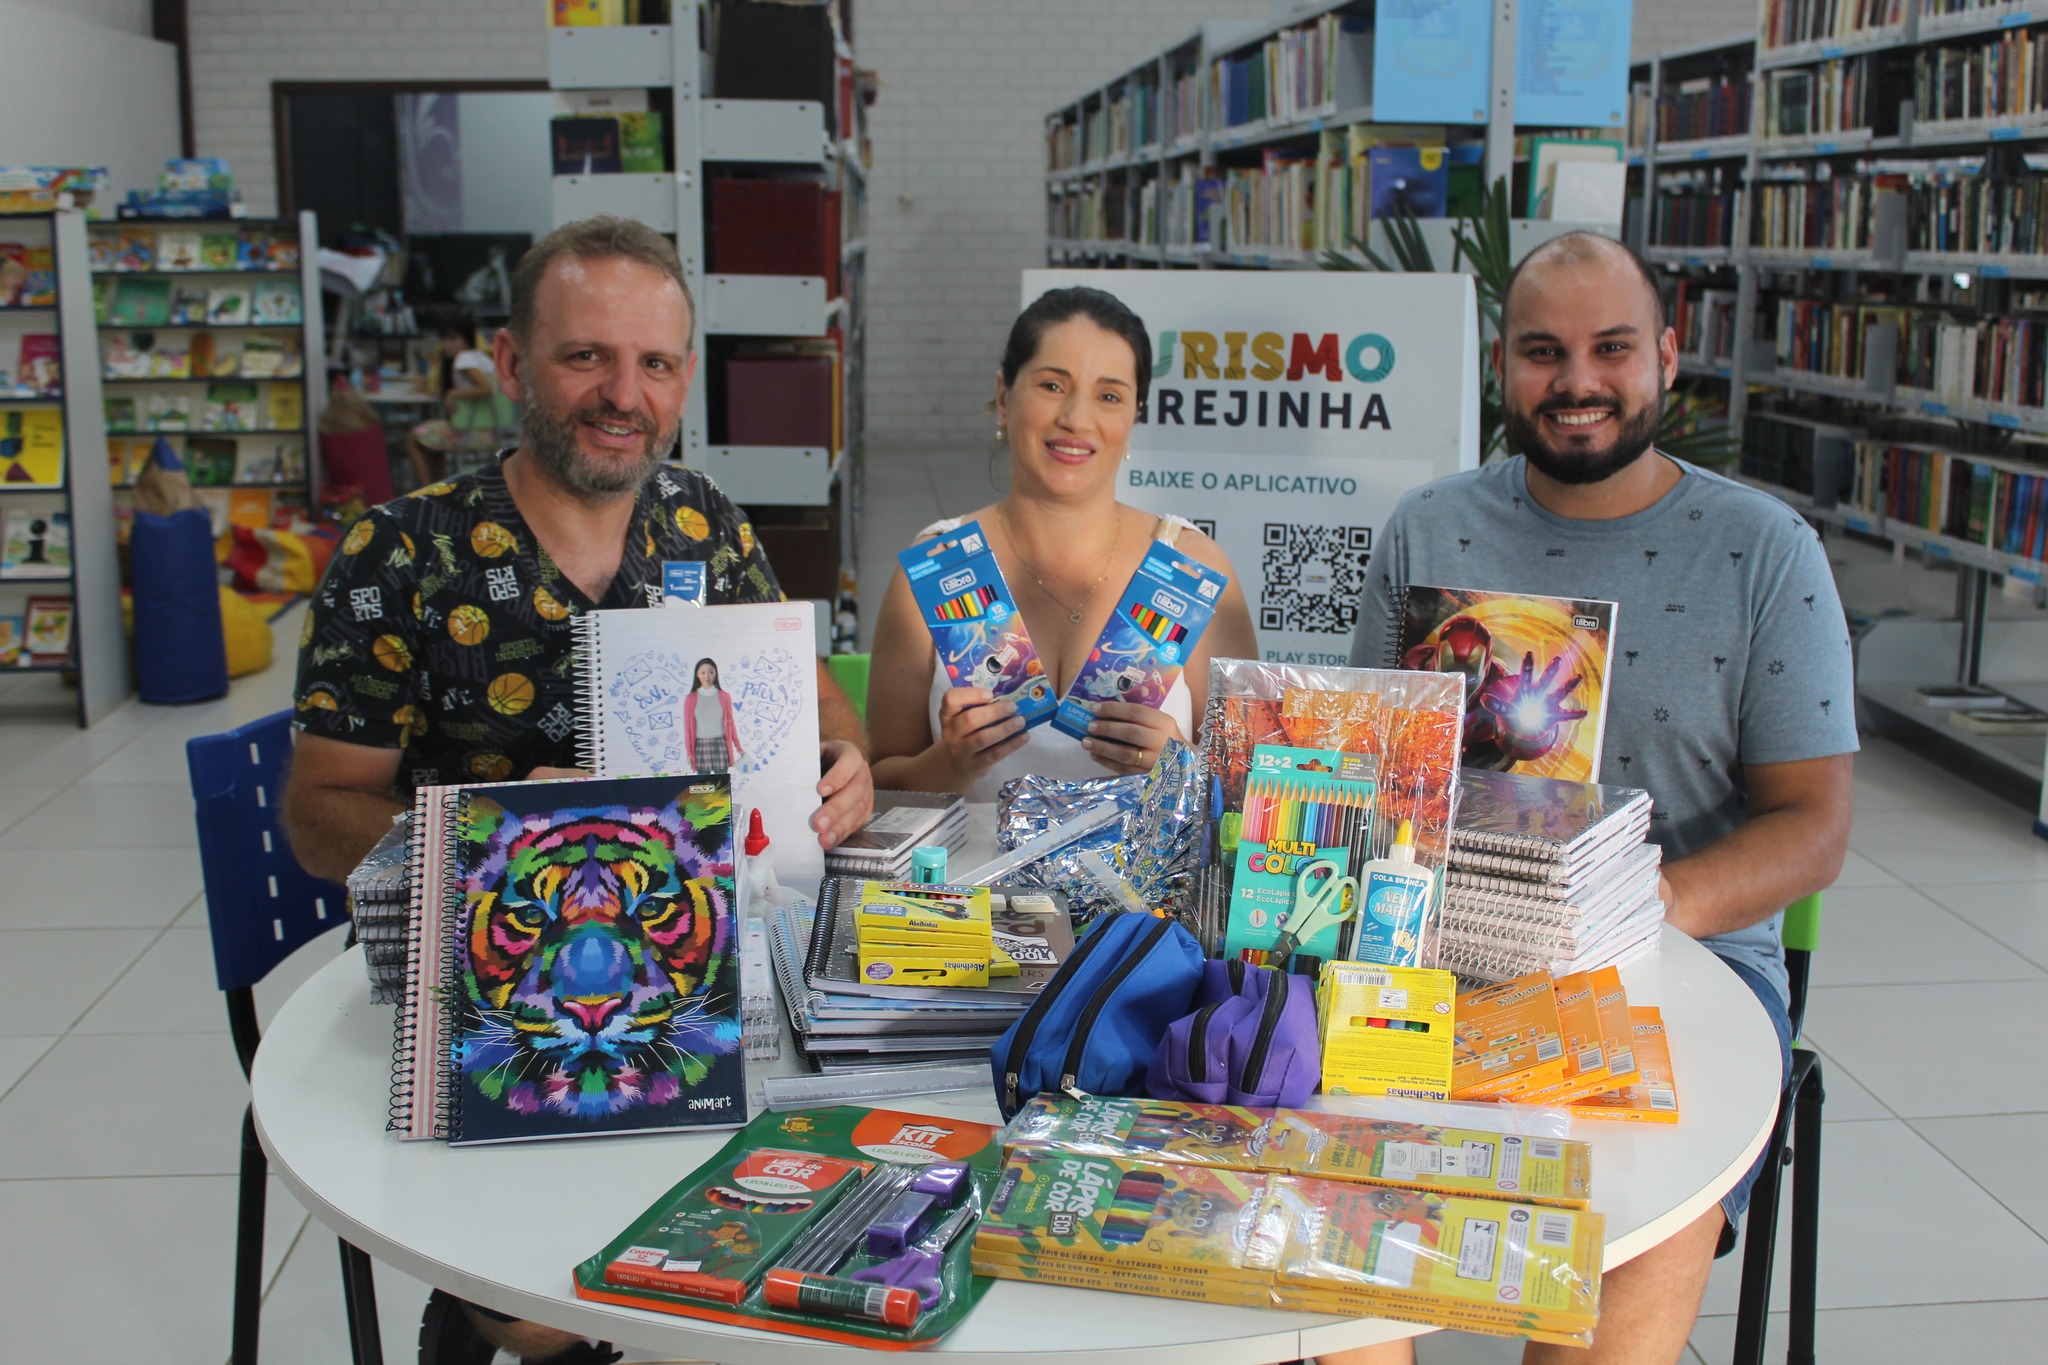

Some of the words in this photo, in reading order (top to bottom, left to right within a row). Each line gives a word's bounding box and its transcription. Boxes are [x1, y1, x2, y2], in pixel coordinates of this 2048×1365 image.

[1152, 331, 1395, 383] URISMO
[1129, 470, 1194, 489] BAIXE
[1201, 472, 1218, 489] O
[1224, 474, 1357, 495] APLICATIVO
[943, 574, 972, 592] tilibra
[350, 586, 381, 606] SPO
[1156, 594, 1182, 614] tilibra
[353, 603, 383, 622] RTS
[1574, 617, 1597, 628] tilibra
[1166, 645, 1178, 656] 12
[1267, 651, 1303, 663] PLAY
[1307, 653, 1348, 666] STOR
[1258, 754, 1292, 769] 12+2
[1267, 839, 1316, 857] MULTI
[1373, 874, 1393, 883] COLA
[1395, 876, 1425, 887] BRANCA
[1241, 888, 1254, 898] 12
[909, 920, 939, 928] Abelhinhas
[944, 962, 985, 971] Abelhinhas
[1387, 1088, 1446, 1100] Abelhinhas
[893, 1127, 946, 1145] KIT
[889, 1139, 936, 1149] Escolar
[872, 1148, 920, 1159] LEO&LEO
[771, 1158, 805, 1169] Lápis
[1058, 1160, 1082, 1181] DE
[762, 1164, 815, 1180] COR
[744, 1178, 788, 1189] LEO&LEO
[1066, 1162, 1114, 1220] LÁPIS
[1044, 1181, 1073, 1212] COR
[1052, 1214, 1073, 1234] ECO
[629, 1248, 665, 1258] Contém
[617, 1274, 640, 1283] LEO&LEO
